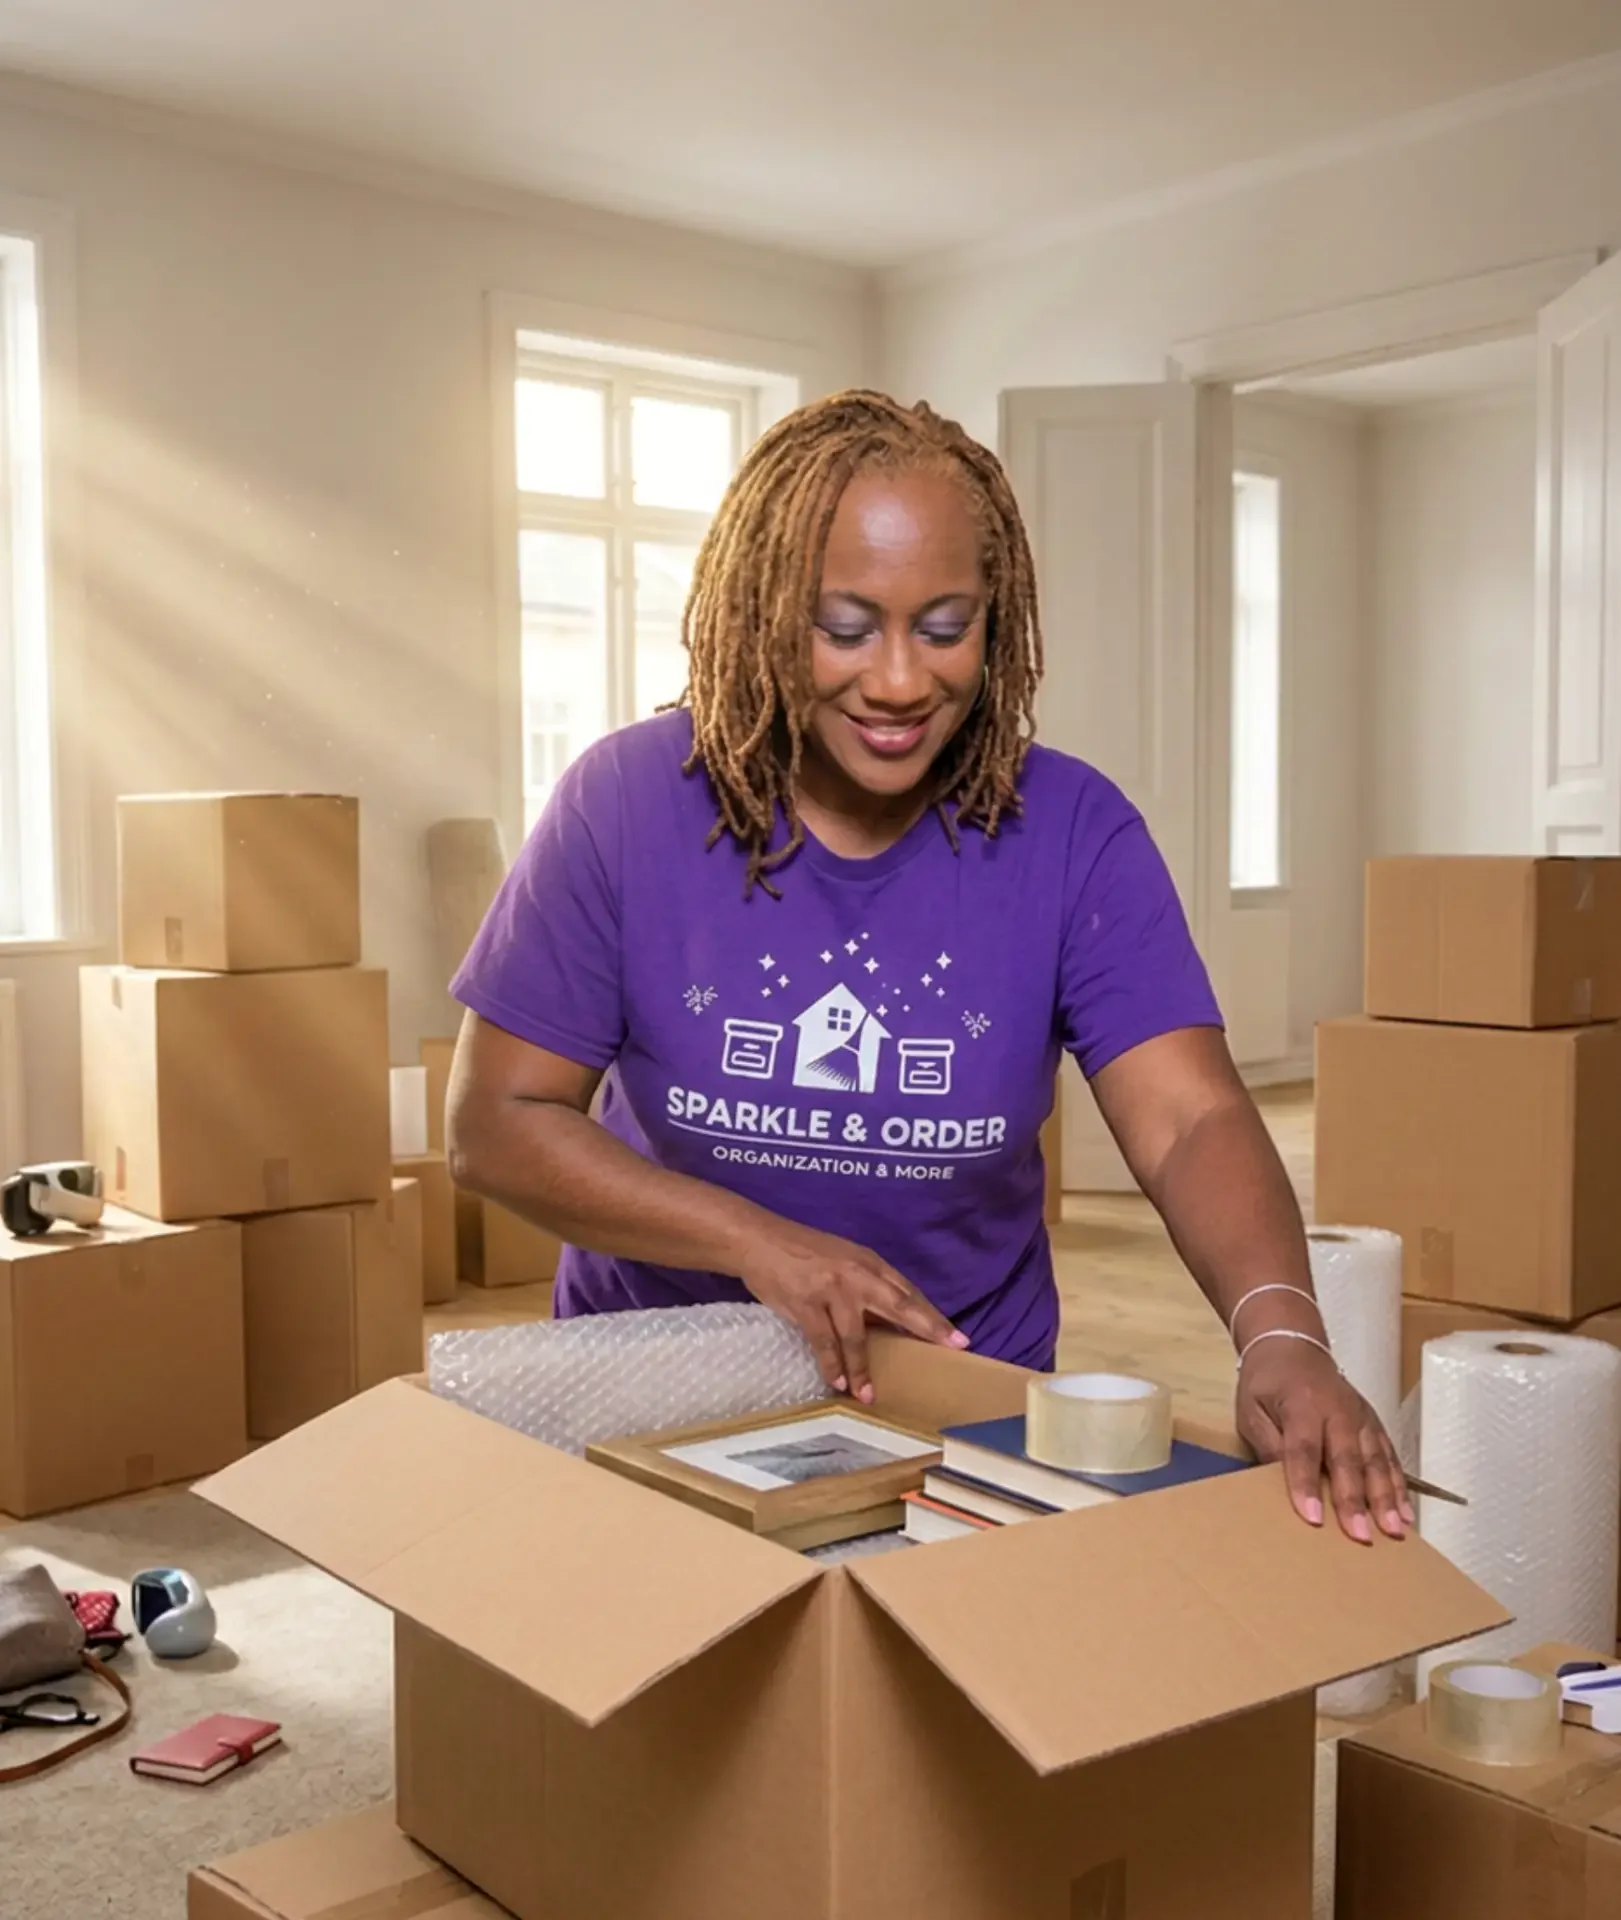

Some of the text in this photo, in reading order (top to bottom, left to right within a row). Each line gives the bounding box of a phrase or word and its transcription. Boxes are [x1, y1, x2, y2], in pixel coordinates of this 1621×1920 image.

[667, 1086, 1006, 1149] SPARKLE & ORDER
[712, 1146, 954, 1180] ORGANIZATION & MORE
